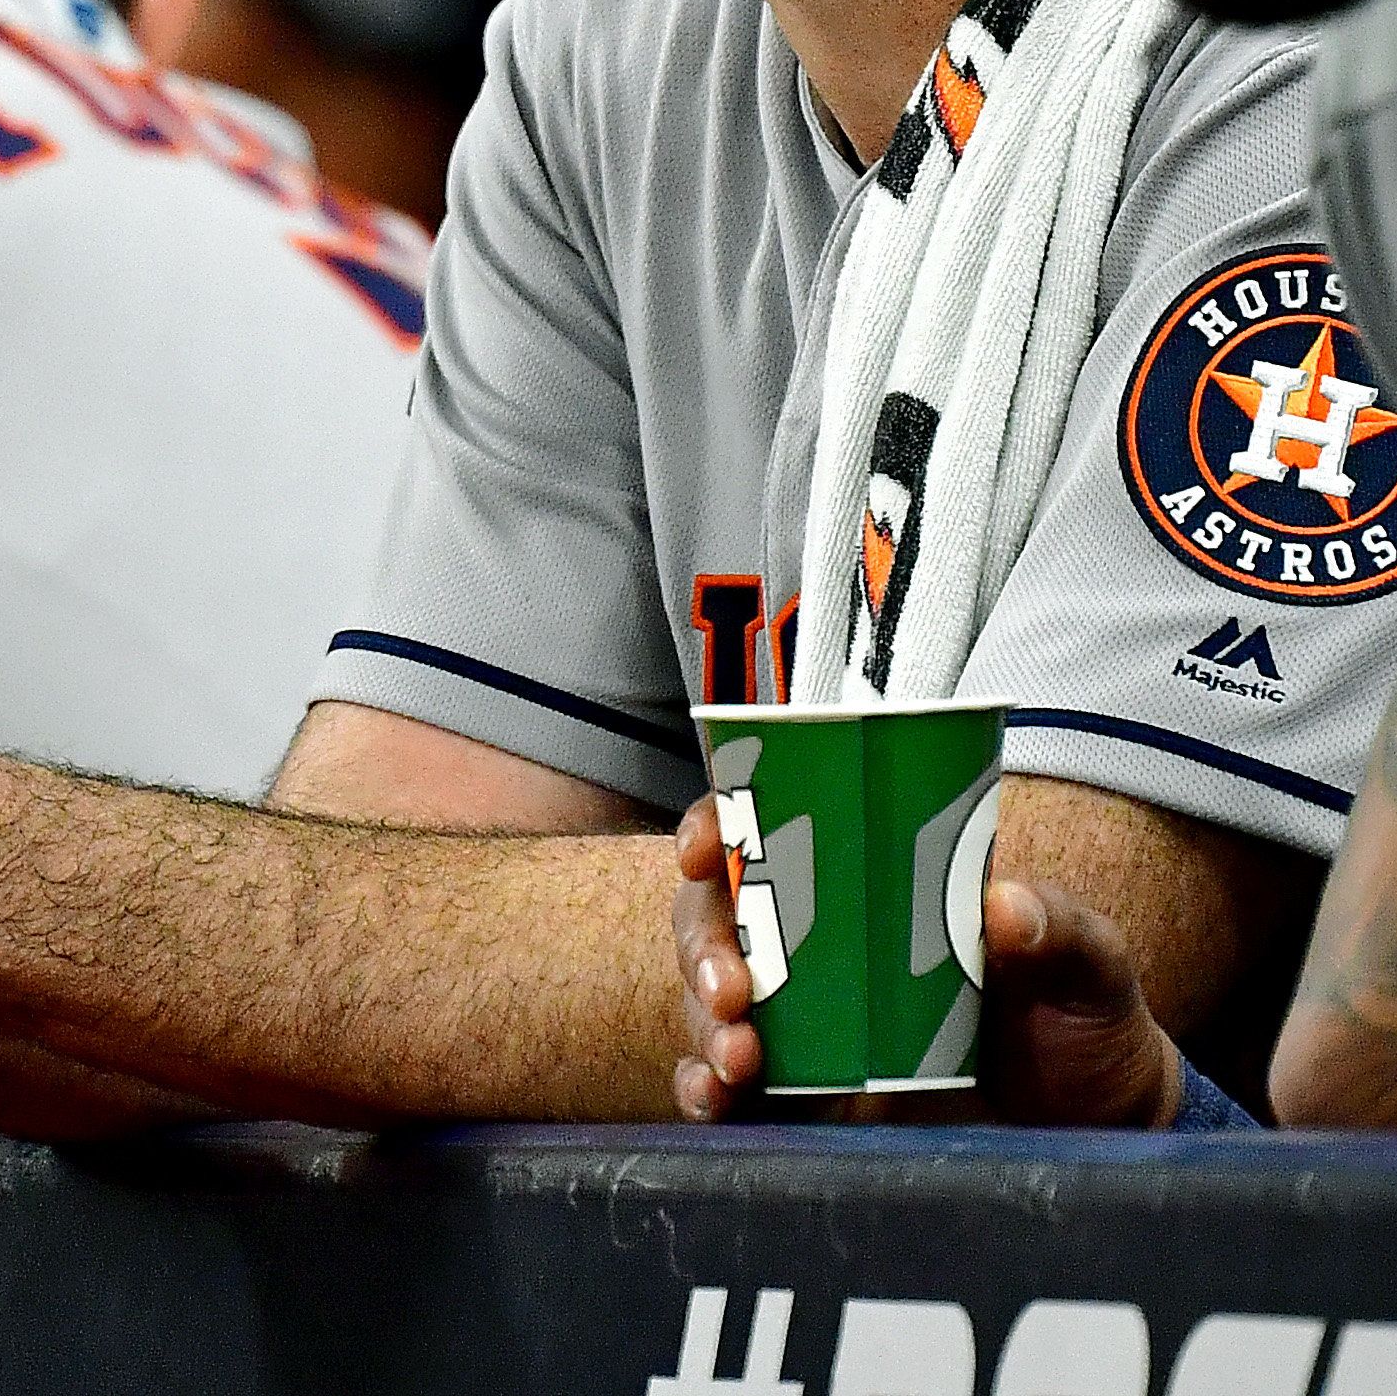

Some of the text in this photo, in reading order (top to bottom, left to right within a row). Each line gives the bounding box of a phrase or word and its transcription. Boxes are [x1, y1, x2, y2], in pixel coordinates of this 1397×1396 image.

[1187, 269, 1348, 348] HOUS
[1228, 359, 1380, 498] H
[1171, 658, 1286, 704] Majestic
